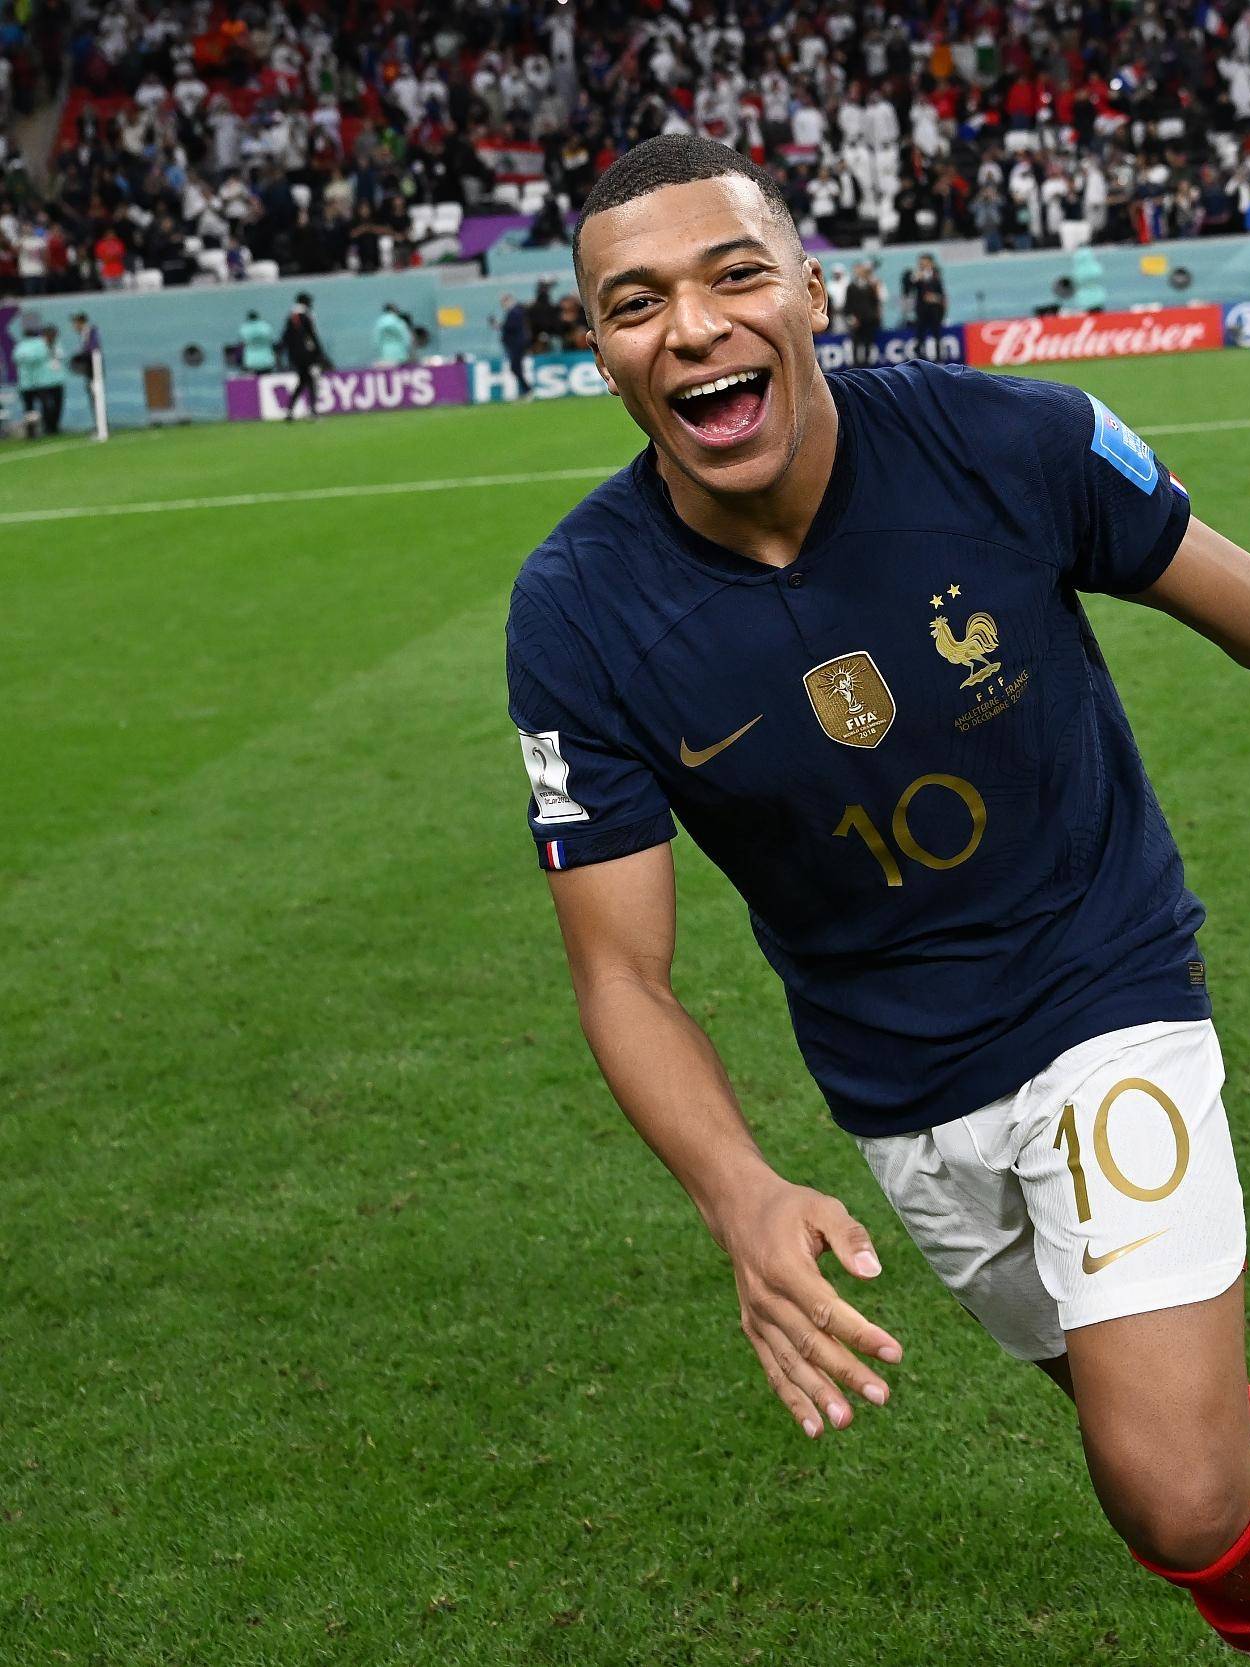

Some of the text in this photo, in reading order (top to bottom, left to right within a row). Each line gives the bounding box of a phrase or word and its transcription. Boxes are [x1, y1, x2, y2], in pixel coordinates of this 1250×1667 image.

[981, 317, 1204, 366] Budweiser
[314, 369, 435, 413] BYJU'S
[845, 711, 877, 731] FIFA
[954, 696, 1000, 728] ANGLETERRE
[1005, 669, 1029, 697] FRANCE
[859, 728, 877, 739] 2018
[832, 773, 987, 887] 10
[1053, 1077, 1190, 1224] 10
